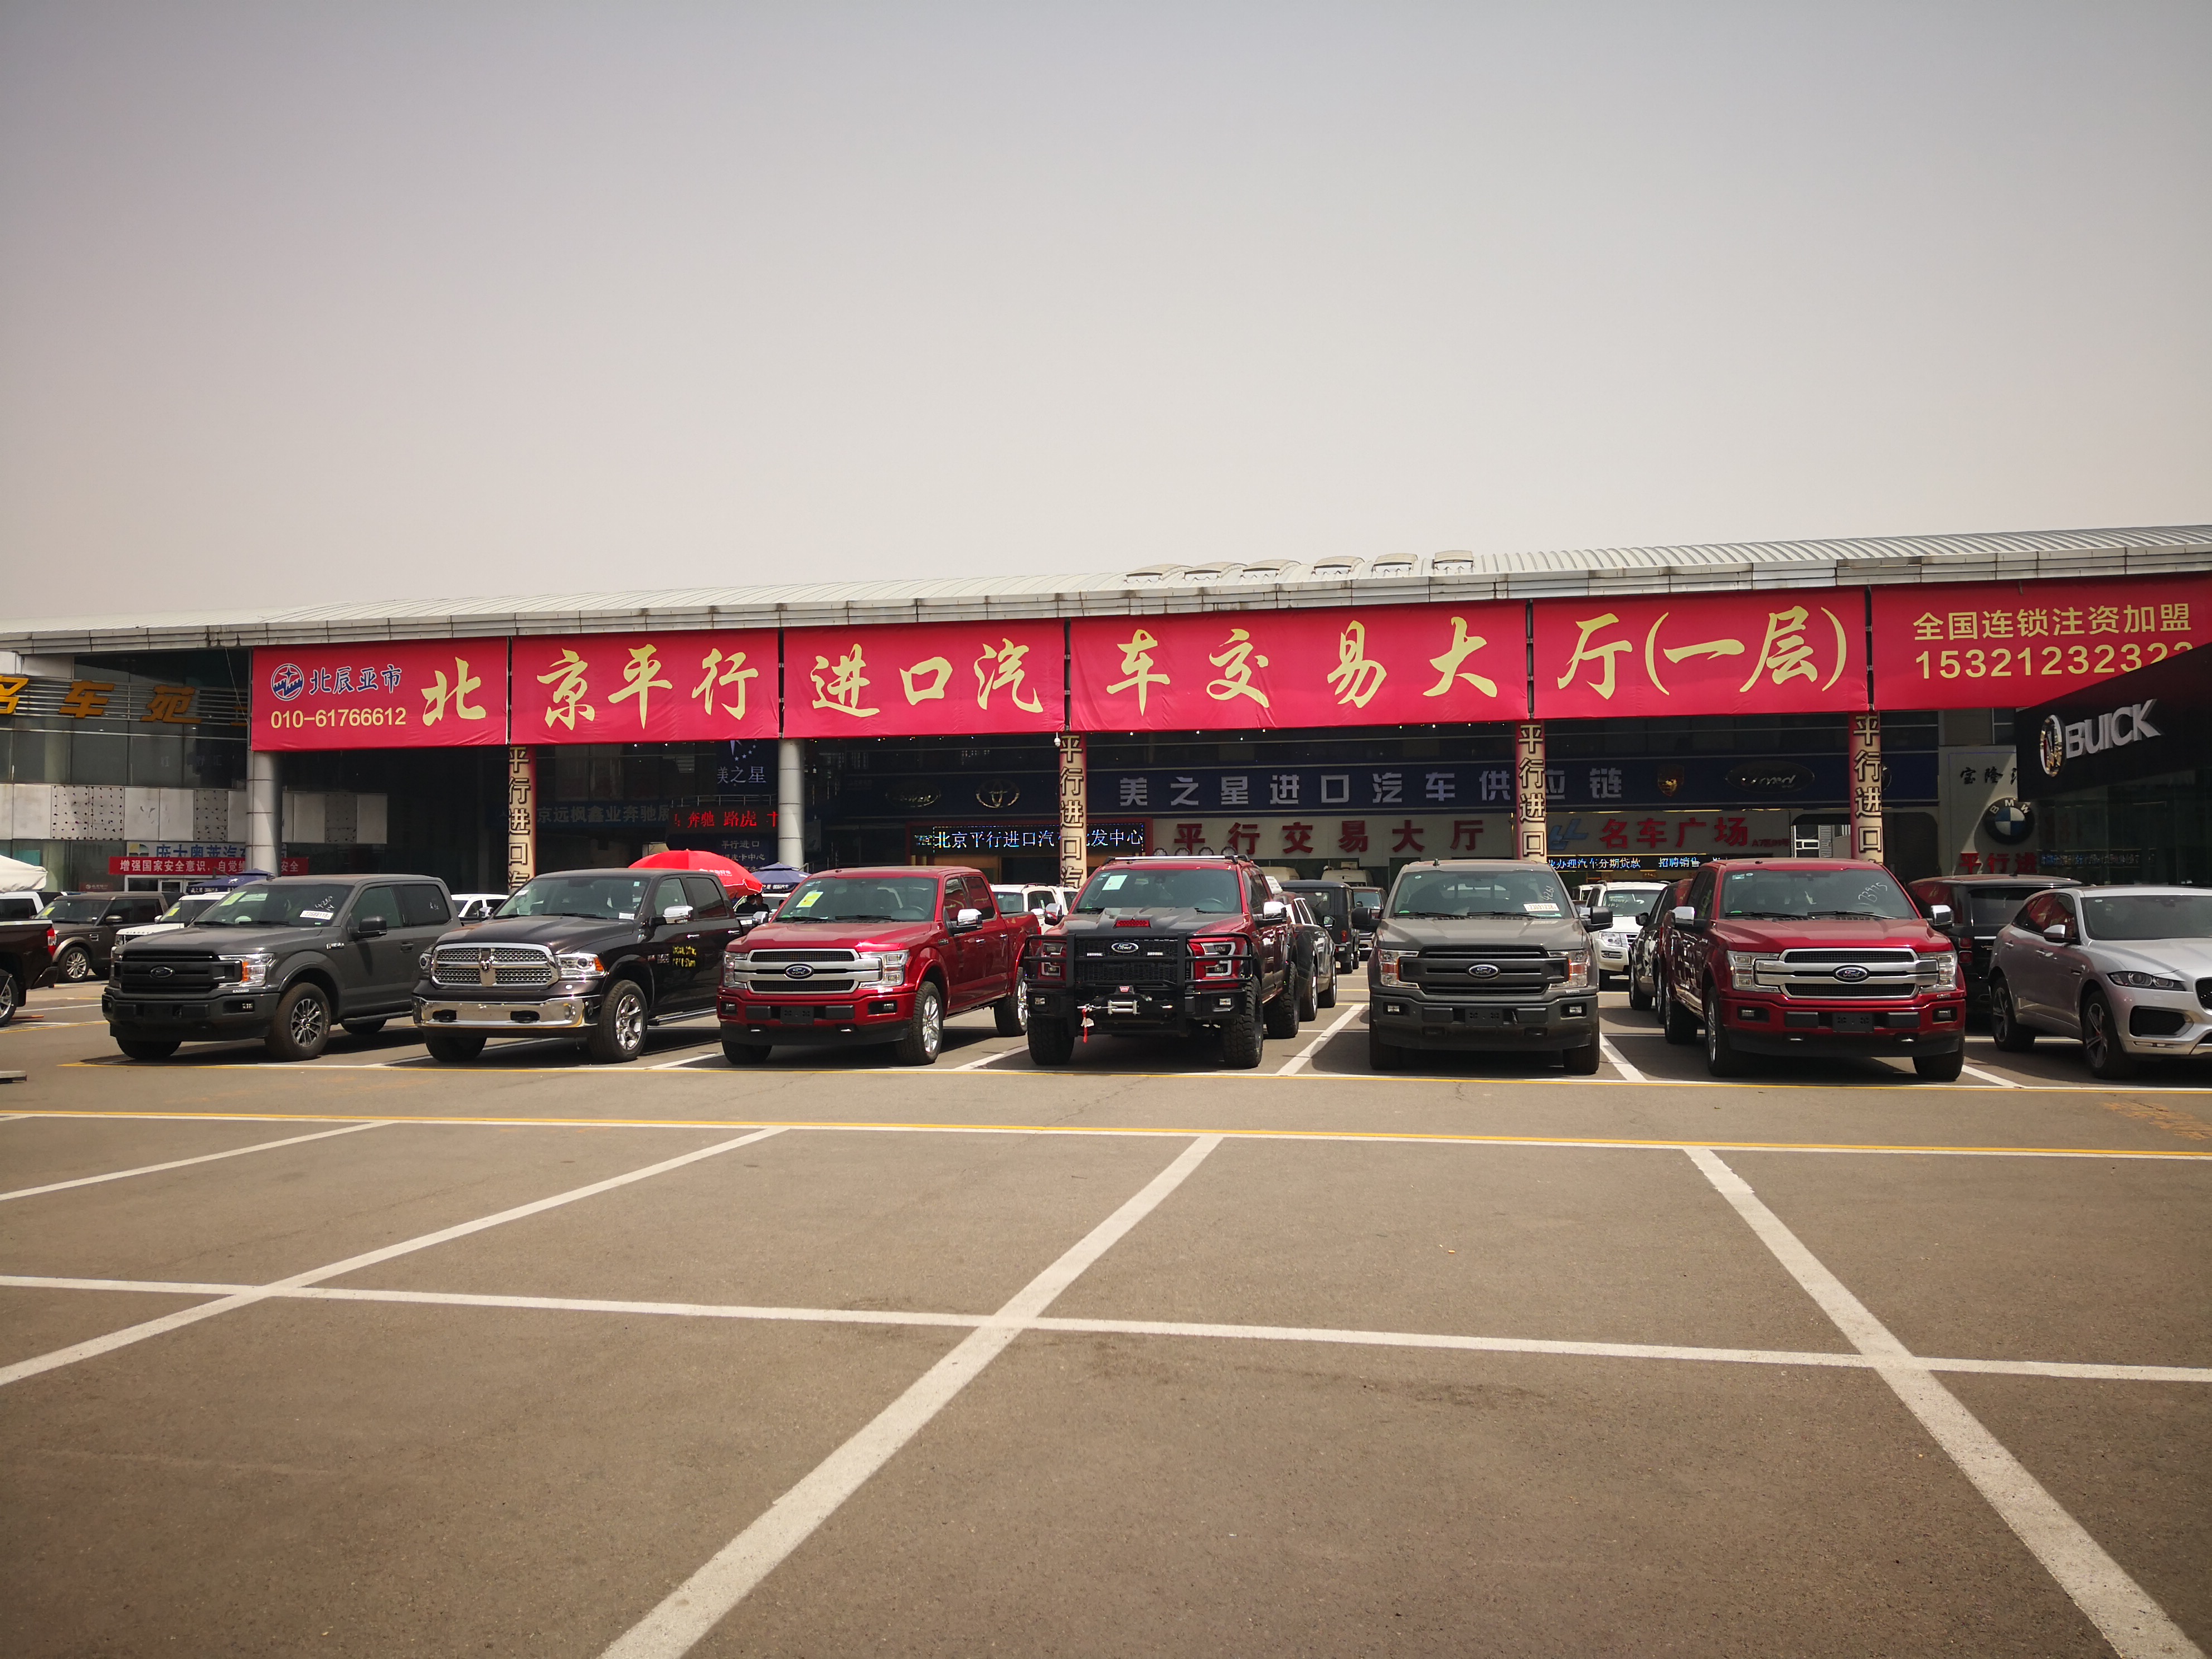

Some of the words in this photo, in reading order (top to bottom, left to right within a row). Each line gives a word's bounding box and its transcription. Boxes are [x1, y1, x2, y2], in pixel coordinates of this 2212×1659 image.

[1913, 603, 2192, 641] 全国连锁注资加盟
[309, 663, 402, 695] 北辰亚市
[271, 707, 406, 729] 010-61766612
[2066, 698, 2163, 759] BUICK
[717, 766, 767, 784] 美之星
[1518, 725, 1545, 856] 平行进口
[1853, 715, 1882, 865] 平行进口
[1990, 799, 2030, 814] BMW
[934, 829, 1143, 848] 北京平行进口汽发中心
[1174, 820, 1483, 854] 平行交易大厅
[1599, 817, 1748, 849] 名车广场
